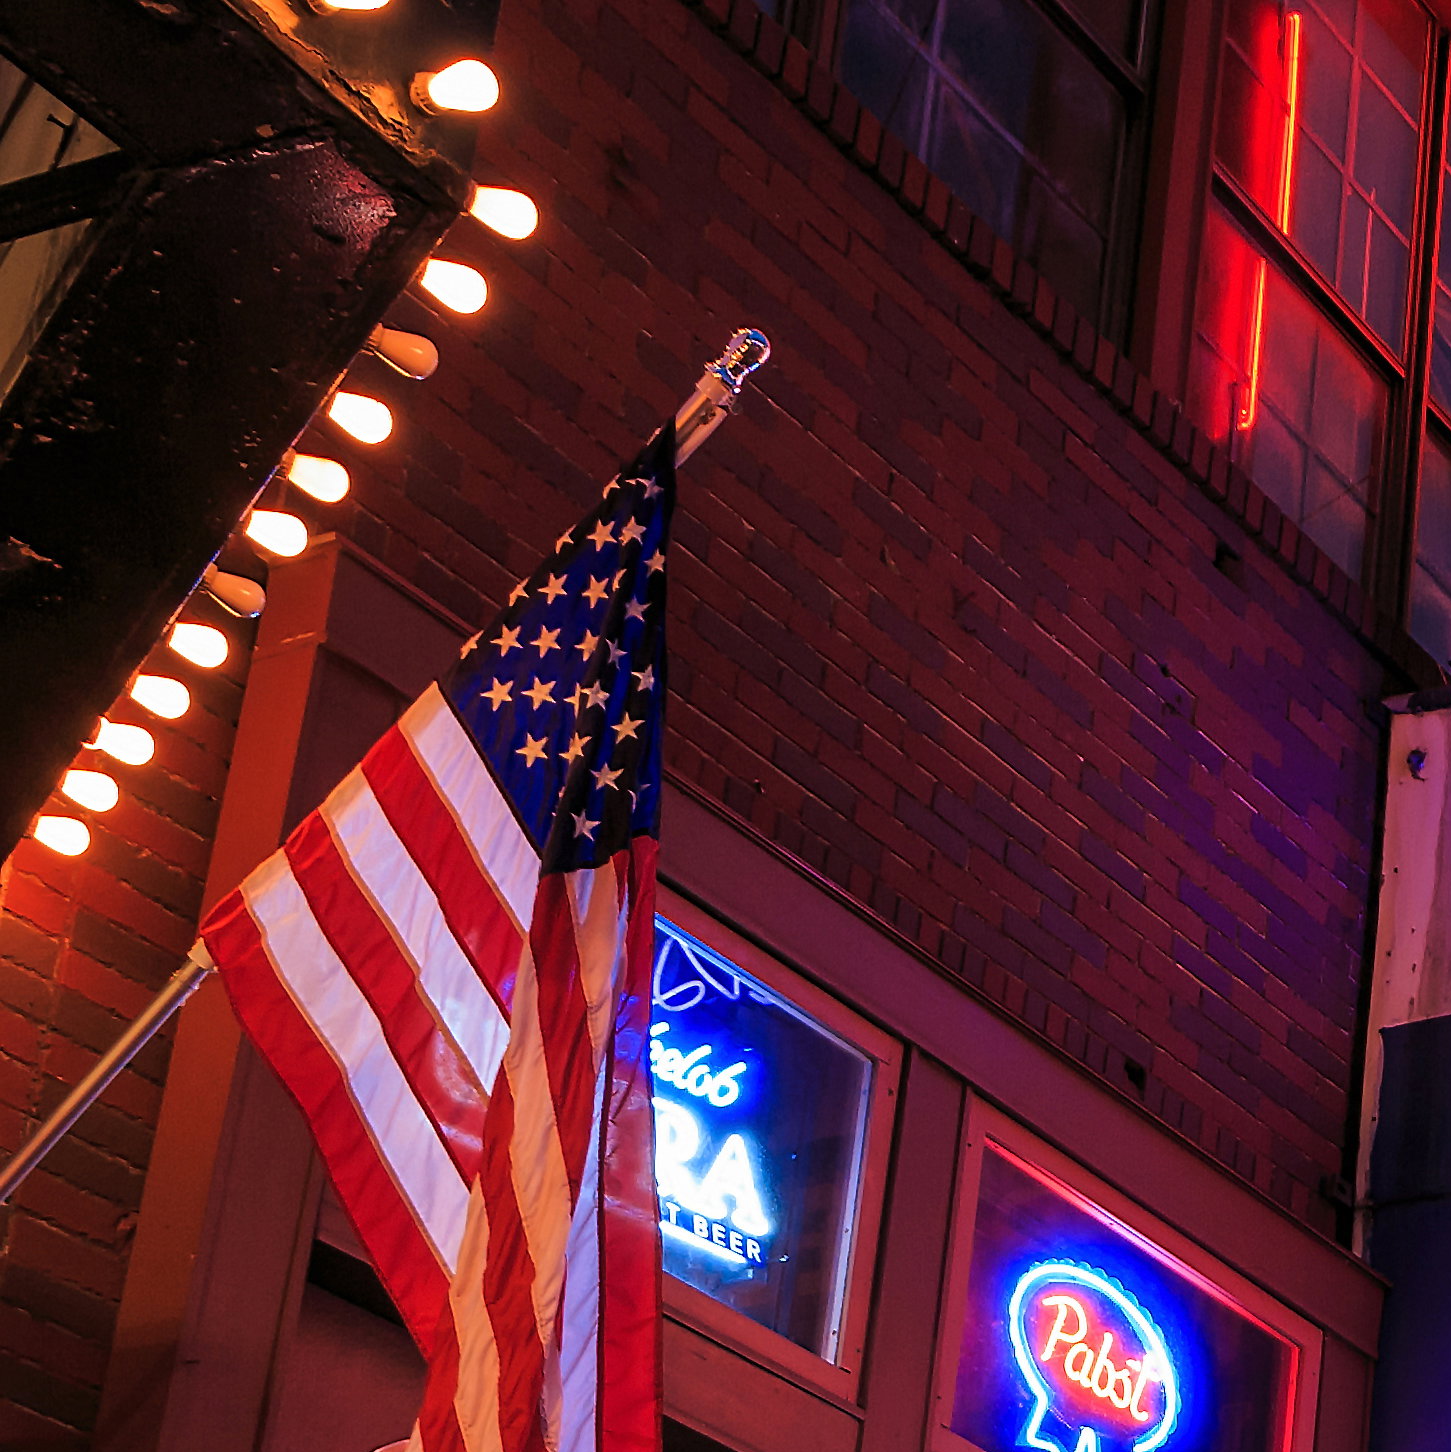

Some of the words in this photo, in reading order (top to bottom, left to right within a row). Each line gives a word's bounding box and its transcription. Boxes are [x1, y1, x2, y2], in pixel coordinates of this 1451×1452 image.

[650, 1021, 746, 1107] elob
[693, 1214, 761, 1264] BEER
[1042, 1296, 1162, 1421] Pabst
